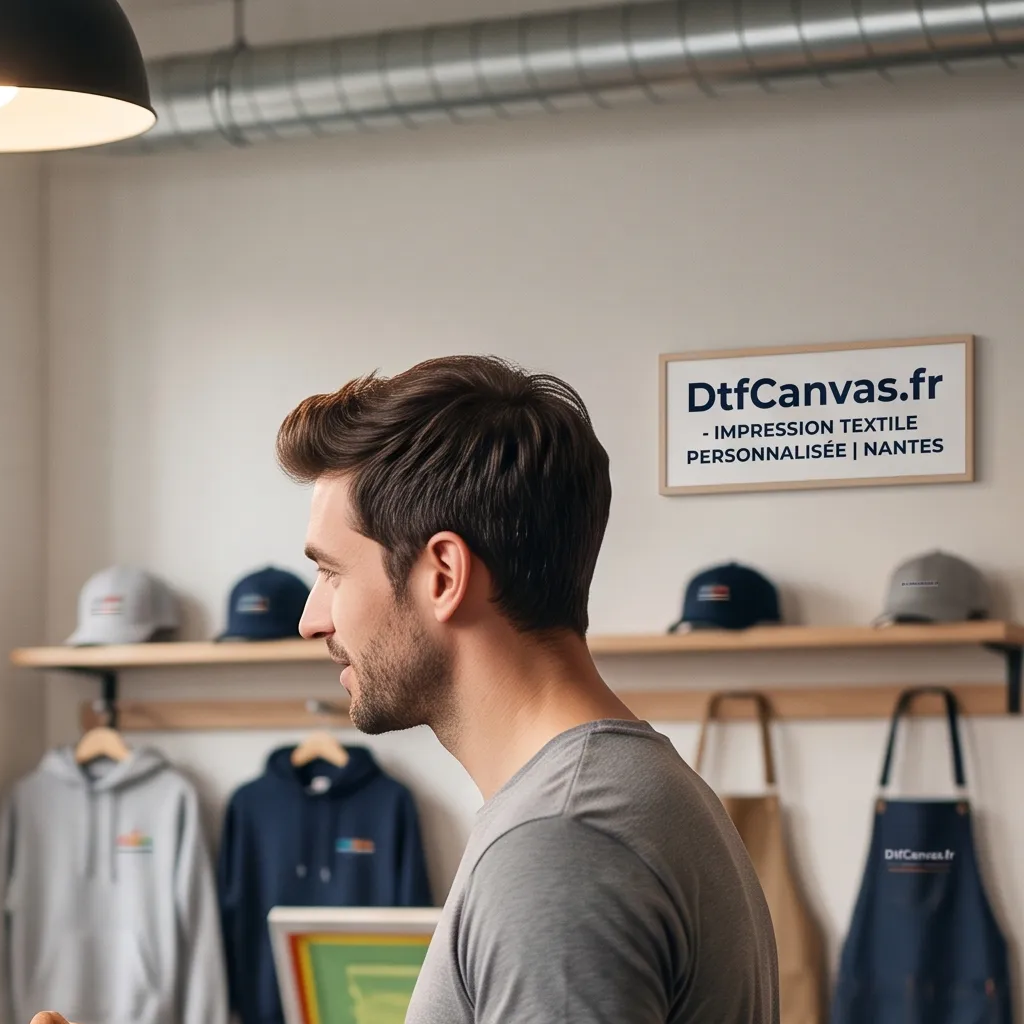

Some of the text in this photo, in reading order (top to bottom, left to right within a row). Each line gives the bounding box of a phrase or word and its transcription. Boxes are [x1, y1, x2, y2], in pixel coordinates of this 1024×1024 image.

[687, 367, 944, 413] DtfCanvas.fr
[713, 420, 834, 440] IMPRESSION
[839, 415, 918, 434] TEXTILE
[686, 440, 847, 465] PERSONNALISÉE
[863, 438, 944, 457] NANTES
